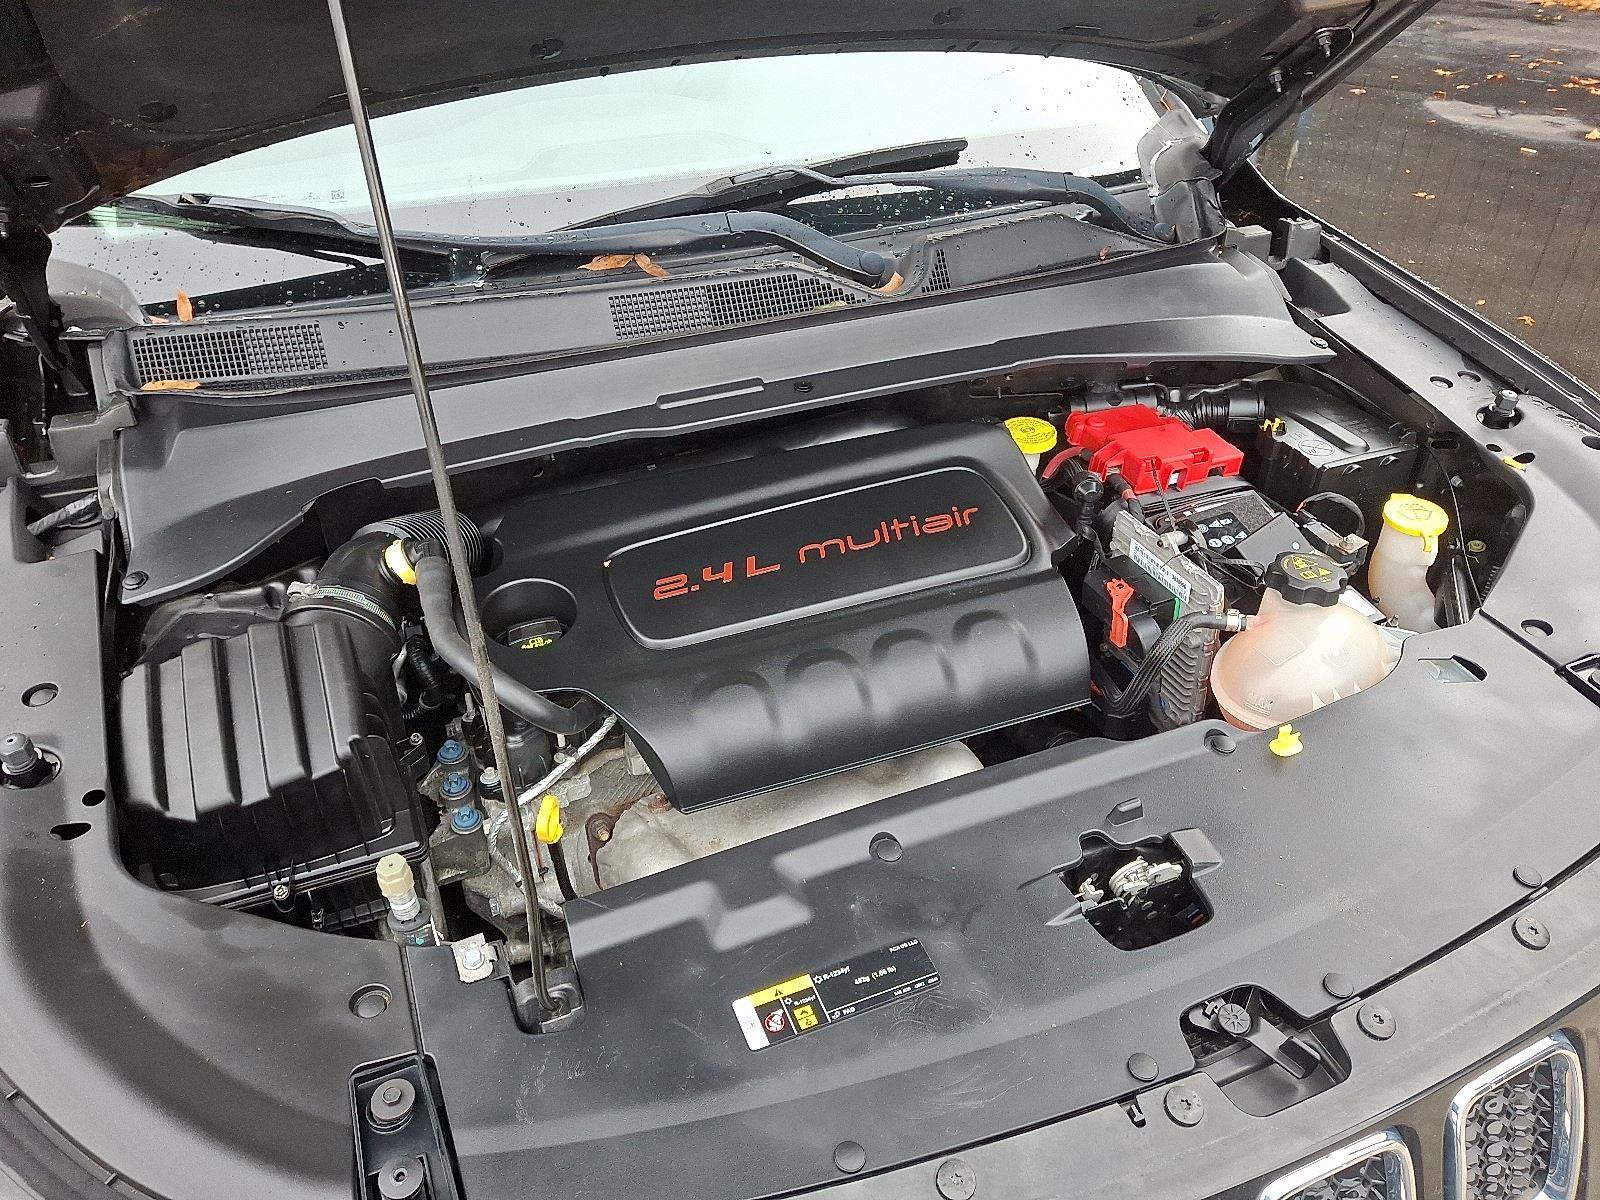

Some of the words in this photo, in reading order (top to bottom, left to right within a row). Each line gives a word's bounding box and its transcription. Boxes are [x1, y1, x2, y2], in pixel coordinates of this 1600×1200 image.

[653, 561, 733, 600] 2.4
[746, 555, 781, 577] L
[799, 506, 978, 563] multiair
